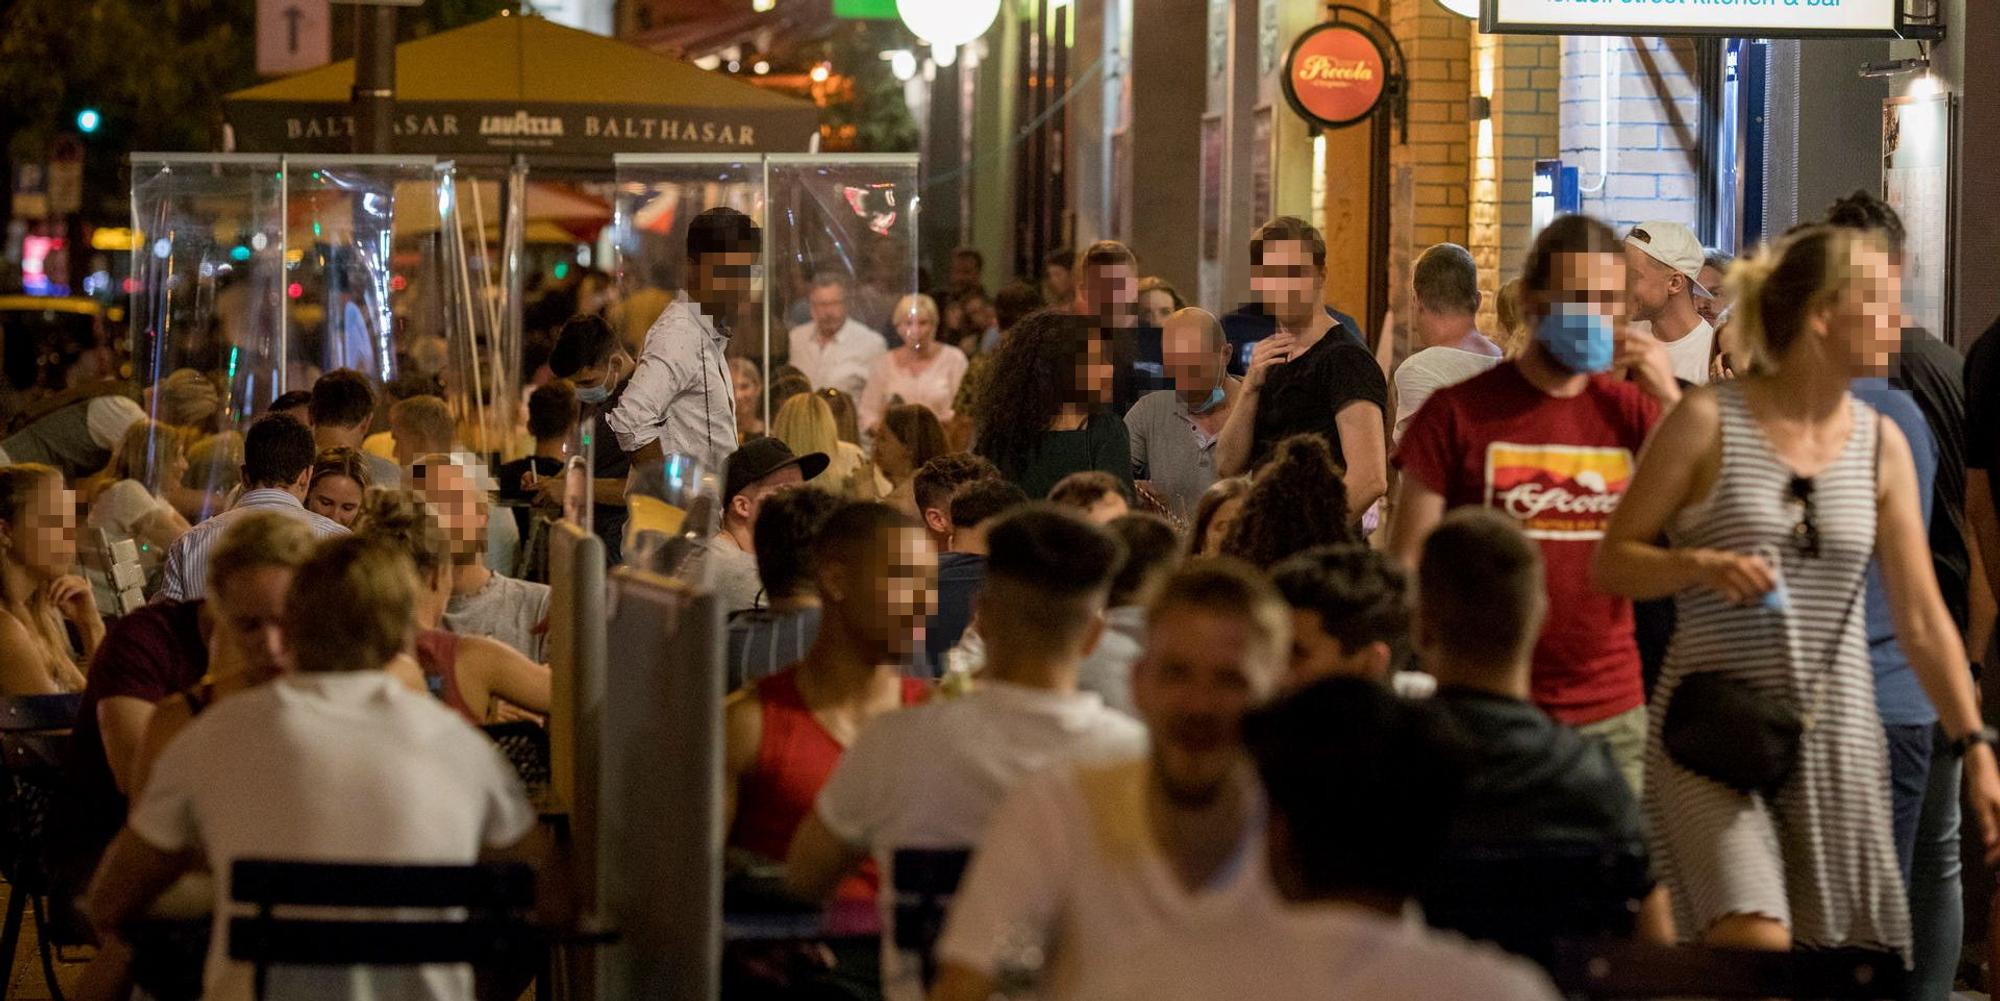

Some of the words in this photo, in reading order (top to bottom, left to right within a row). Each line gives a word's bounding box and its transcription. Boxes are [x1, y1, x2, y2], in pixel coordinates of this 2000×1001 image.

[1299, 54, 1372, 80] Piccola
[286, 114, 460, 138] BALTSAR
[584, 115, 755, 146] BALTHASAR
